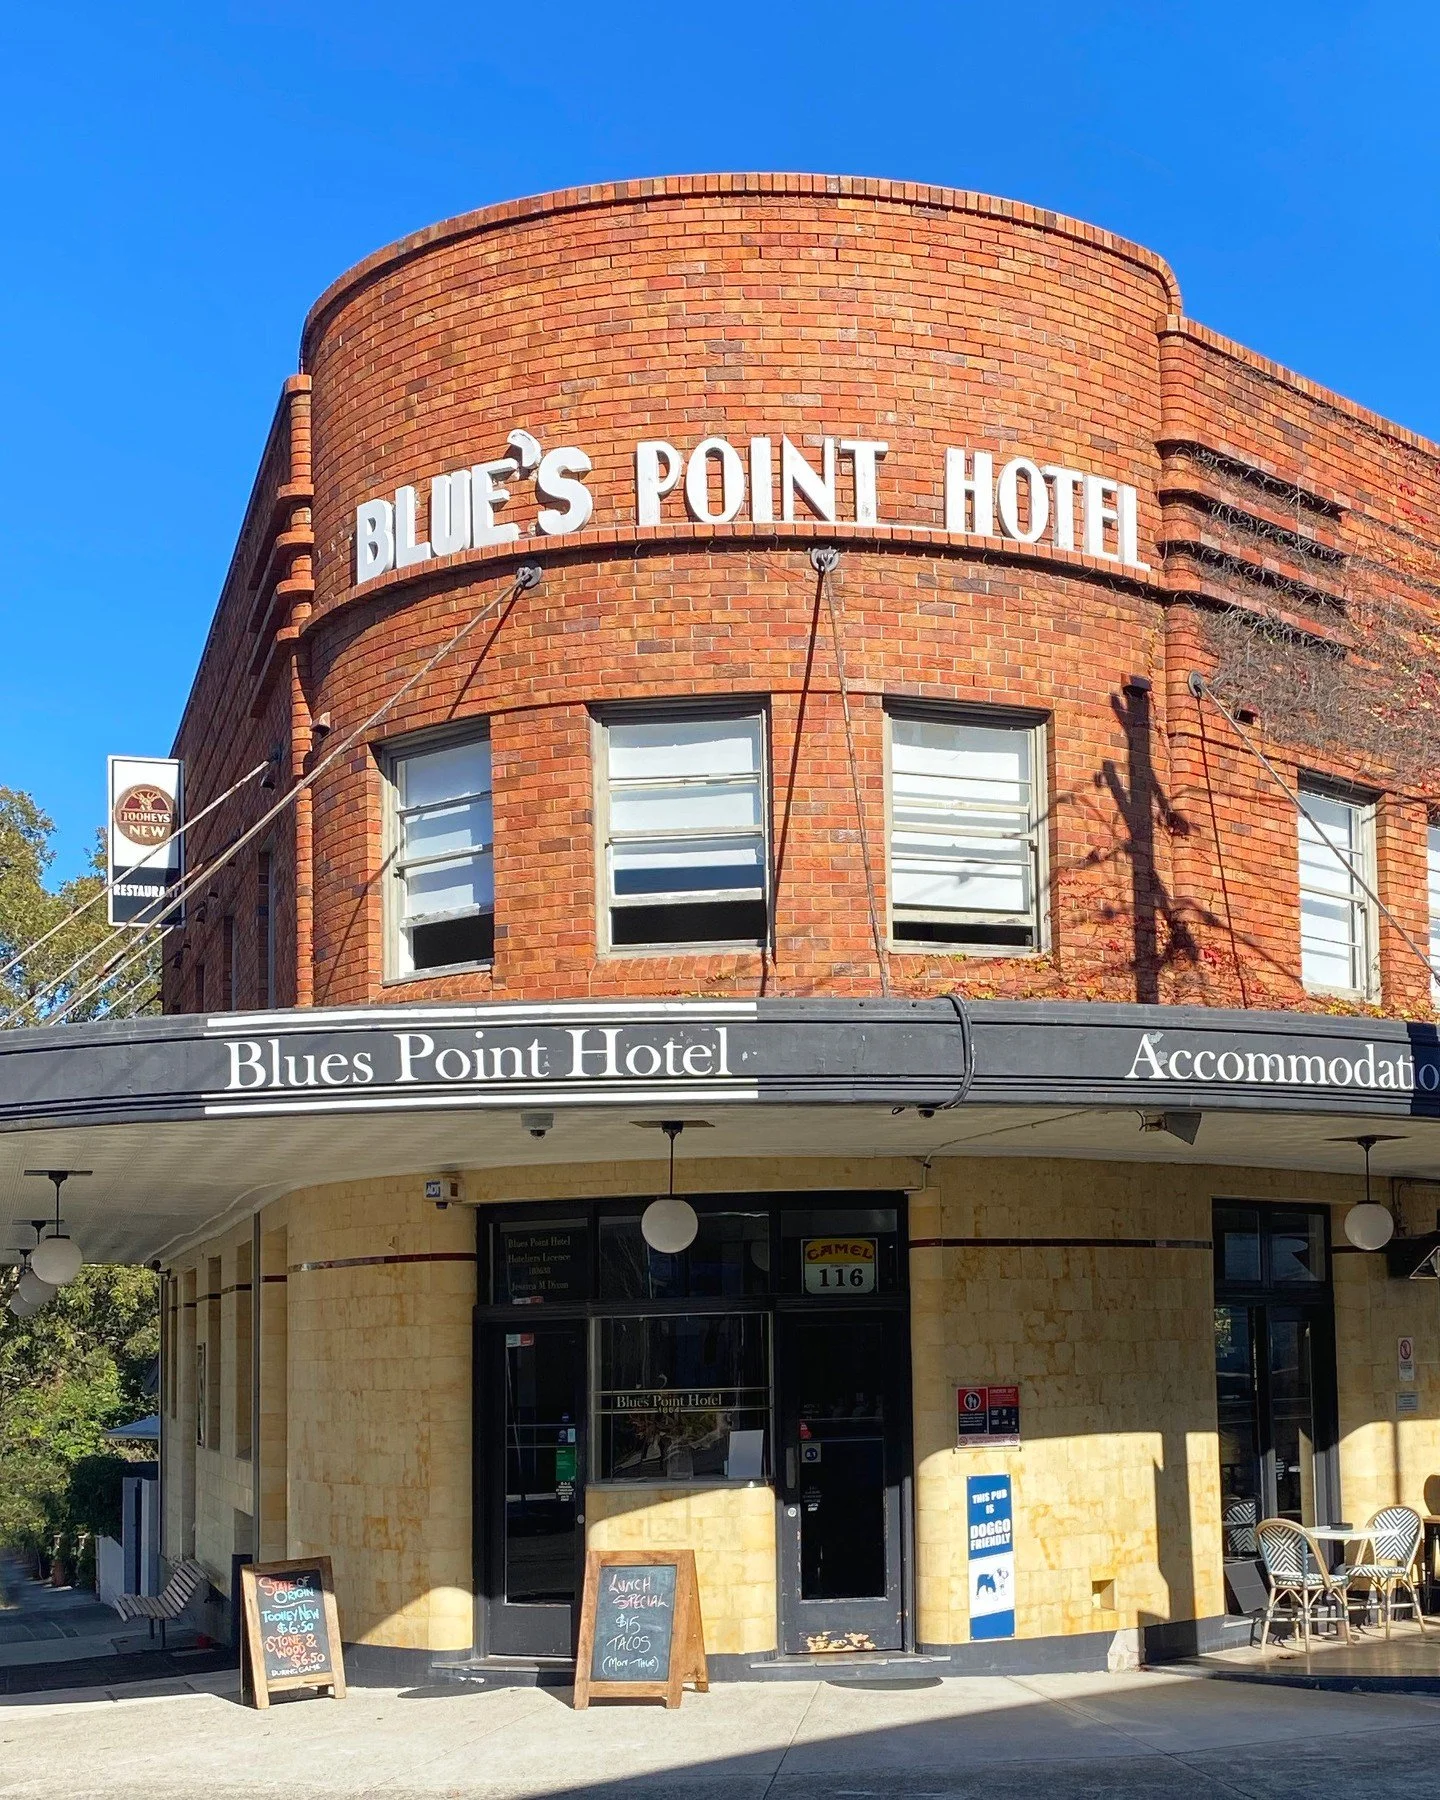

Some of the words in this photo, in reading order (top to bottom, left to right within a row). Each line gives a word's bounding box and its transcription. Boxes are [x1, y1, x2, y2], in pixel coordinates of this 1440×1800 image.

[356, 429, 593, 584] BLUE'S
[636, 435, 889, 526] POINT
[945, 447, 1151, 572] HOTEL
[122, 811, 171, 824] TOOHEYS
[129, 825, 166, 838] NEW
[224, 1038, 373, 1091] Blues
[394, 1030, 549, 1083] Point
[565, 1026, 733, 1078] Hotel
[807, 1243, 873, 1260] CAMEL
[819, 1268, 863, 1287] 116
[653, 1394, 684, 1407] Point
[688, 1393, 722, 1406] Hotel
[972, 1491, 990, 1505] THIS
[991, 1489, 1008, 1502] PUB
[985, 1503, 994, 1515] IS
[970, 1518, 1011, 1540] DOGGO
[970, 1532, 1011, 1551] FRIENDLY
[296, 1576, 310, 1587] OF
[608, 1574, 651, 1594] LUNCH
[274, 1588, 315, 1603] ORIGIN
[612, 1593, 669, 1610] SPECIAL
[616, 1613, 641, 1635] $15
[264, 1634, 304, 1652] STONE
[306, 1633, 317, 1648] &
[275, 1642, 306, 1659] WOOD
[606, 1633, 651, 1653] TACOS
